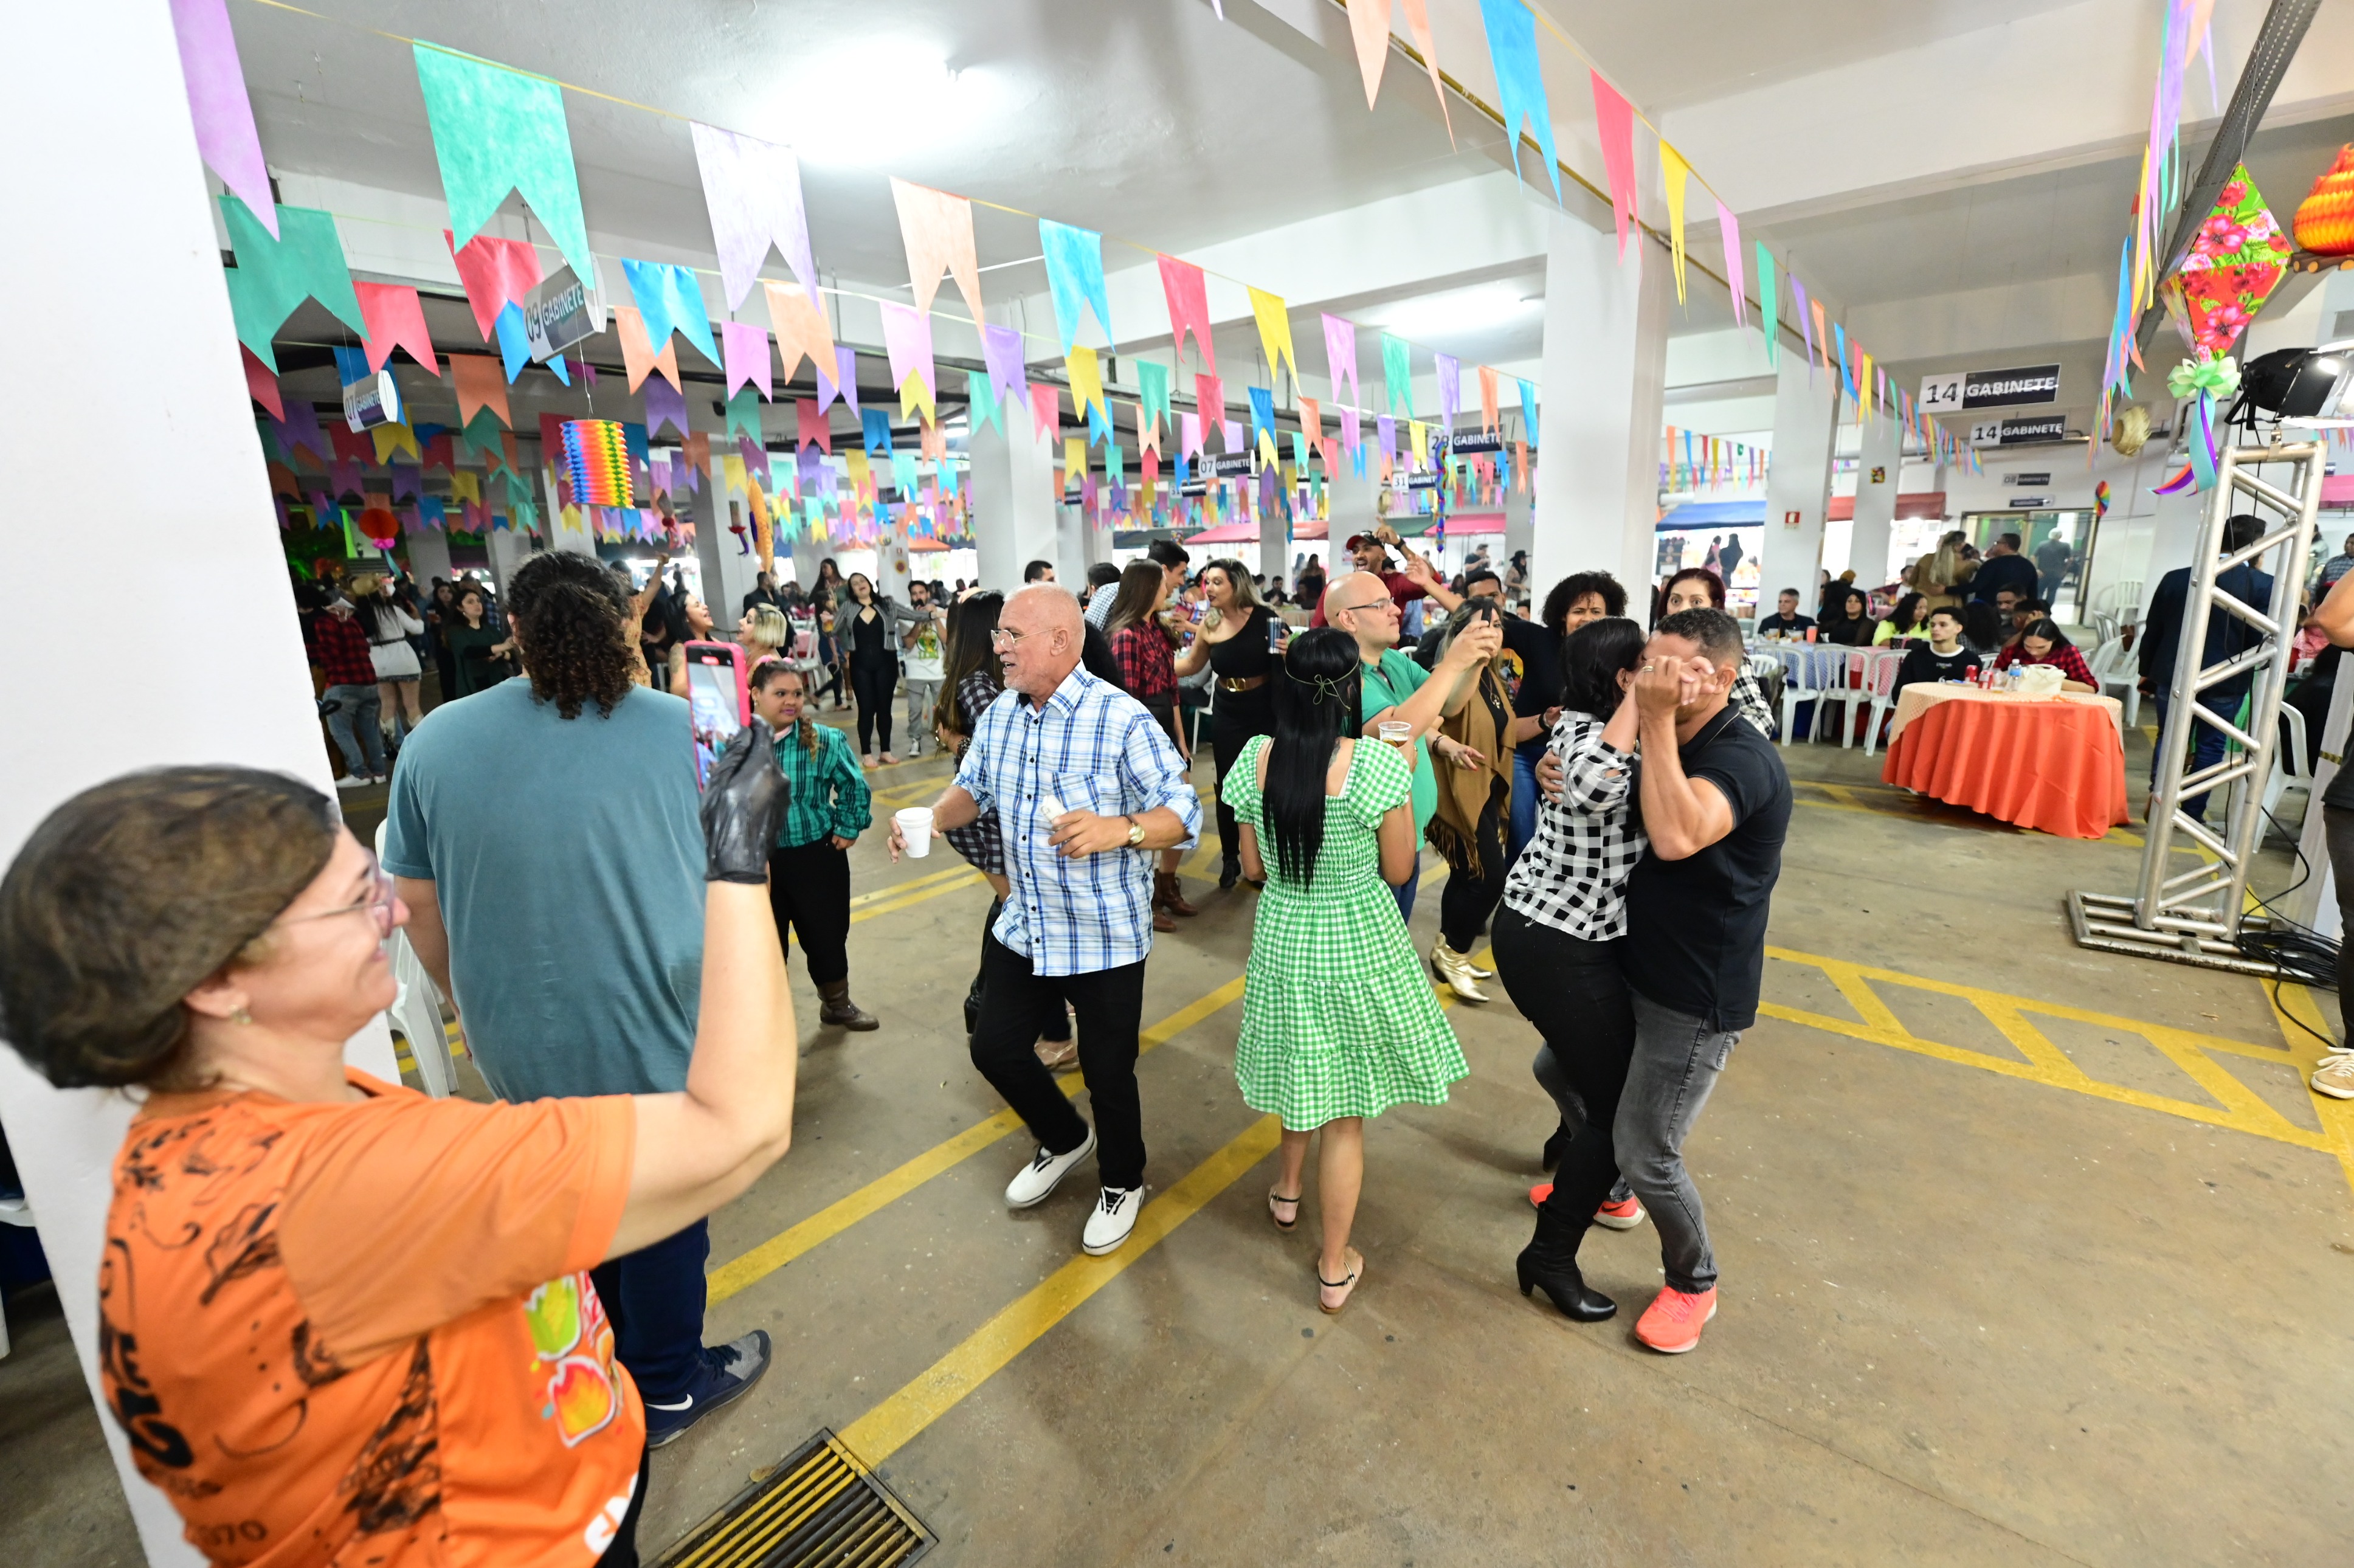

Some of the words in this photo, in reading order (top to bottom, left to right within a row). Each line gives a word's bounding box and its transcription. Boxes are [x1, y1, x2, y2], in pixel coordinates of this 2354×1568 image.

[526, 302, 541, 342] 09
[542, 281, 584, 326] GABINETE
[1926, 382, 1958, 403] 14
[1967, 377, 2055, 398] GABINETE
[1975, 426, 1997, 440] 14
[2003, 423, 2062, 436] GABINETE
[1201, 461, 1213, 473] 07
[1217, 458, 1250, 470] GABINETE
[1395, 477, 1405, 486] 31
[1409, 475, 1437, 485] GABINET
